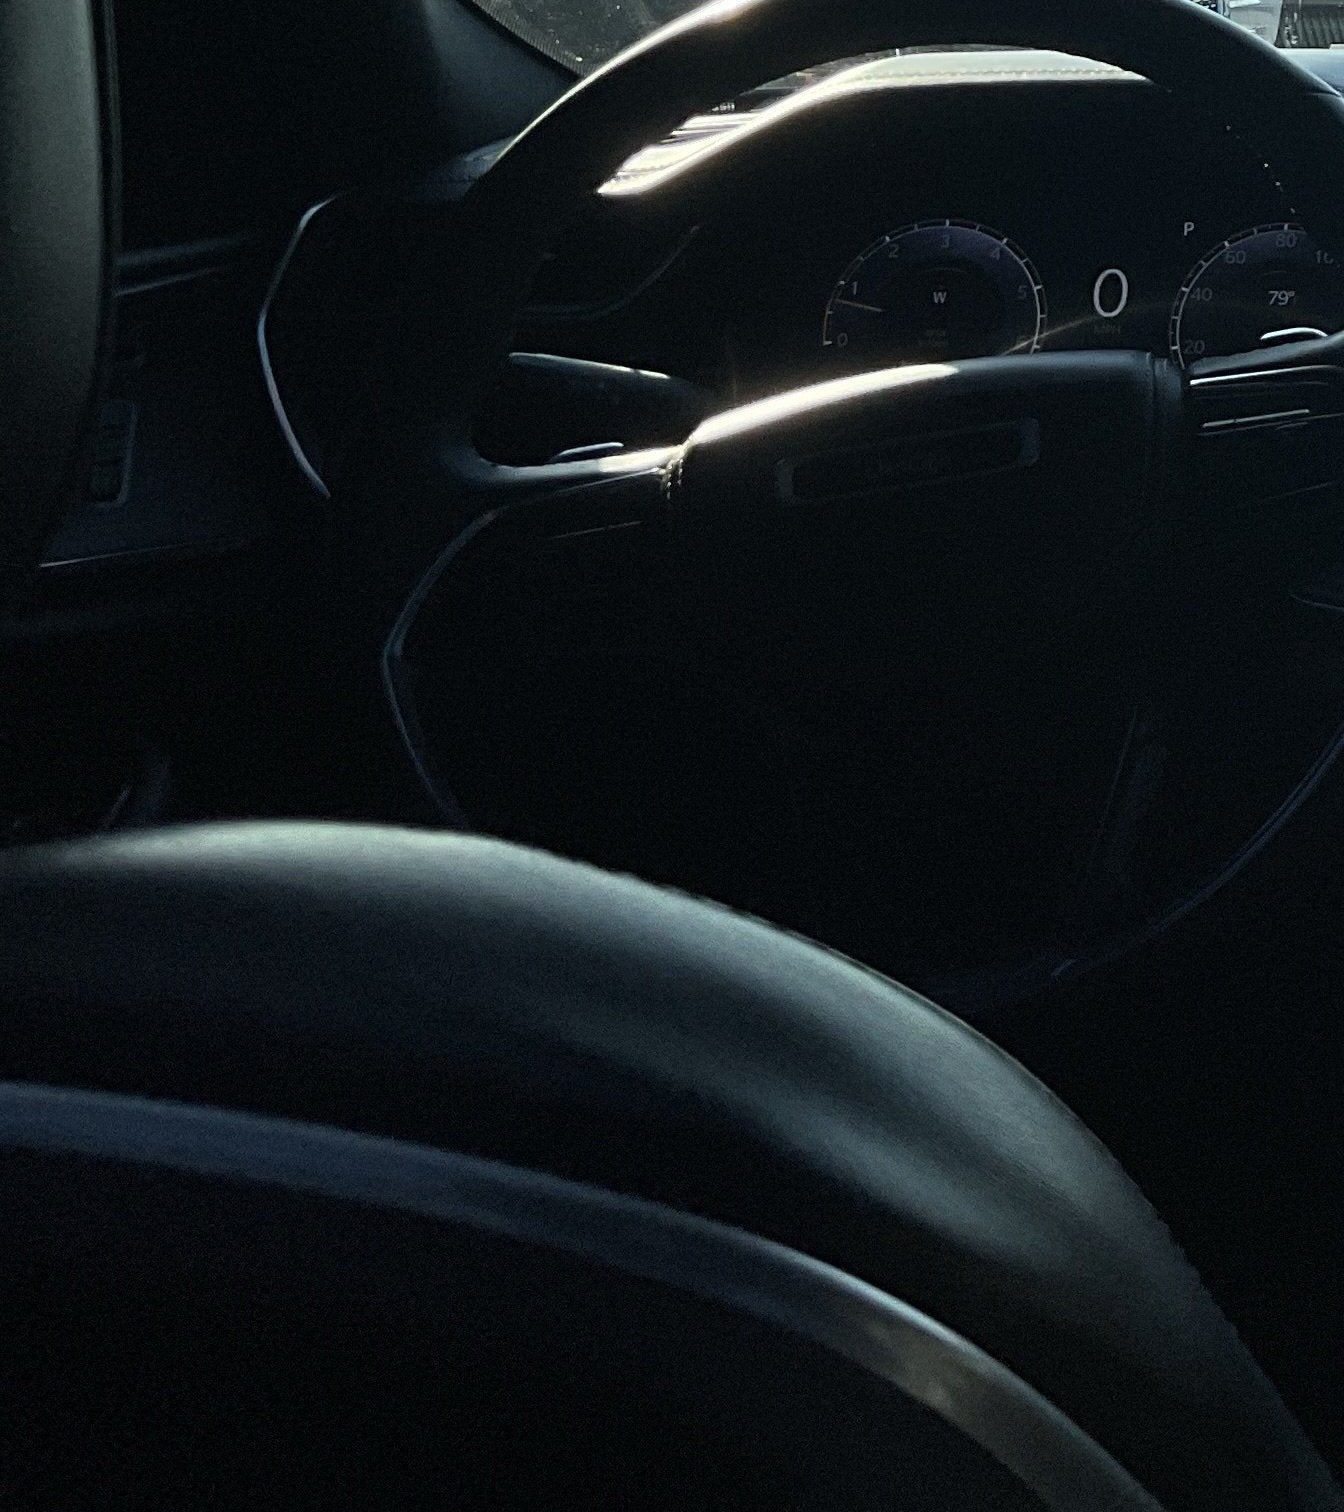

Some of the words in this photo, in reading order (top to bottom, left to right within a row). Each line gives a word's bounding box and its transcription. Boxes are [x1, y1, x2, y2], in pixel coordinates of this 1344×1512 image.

[1183, 222, 1195, 236] P
[888, 244, 900, 258] 2
[933, 291, 948, 304] W
[1093, 268, 1129, 318] 0
